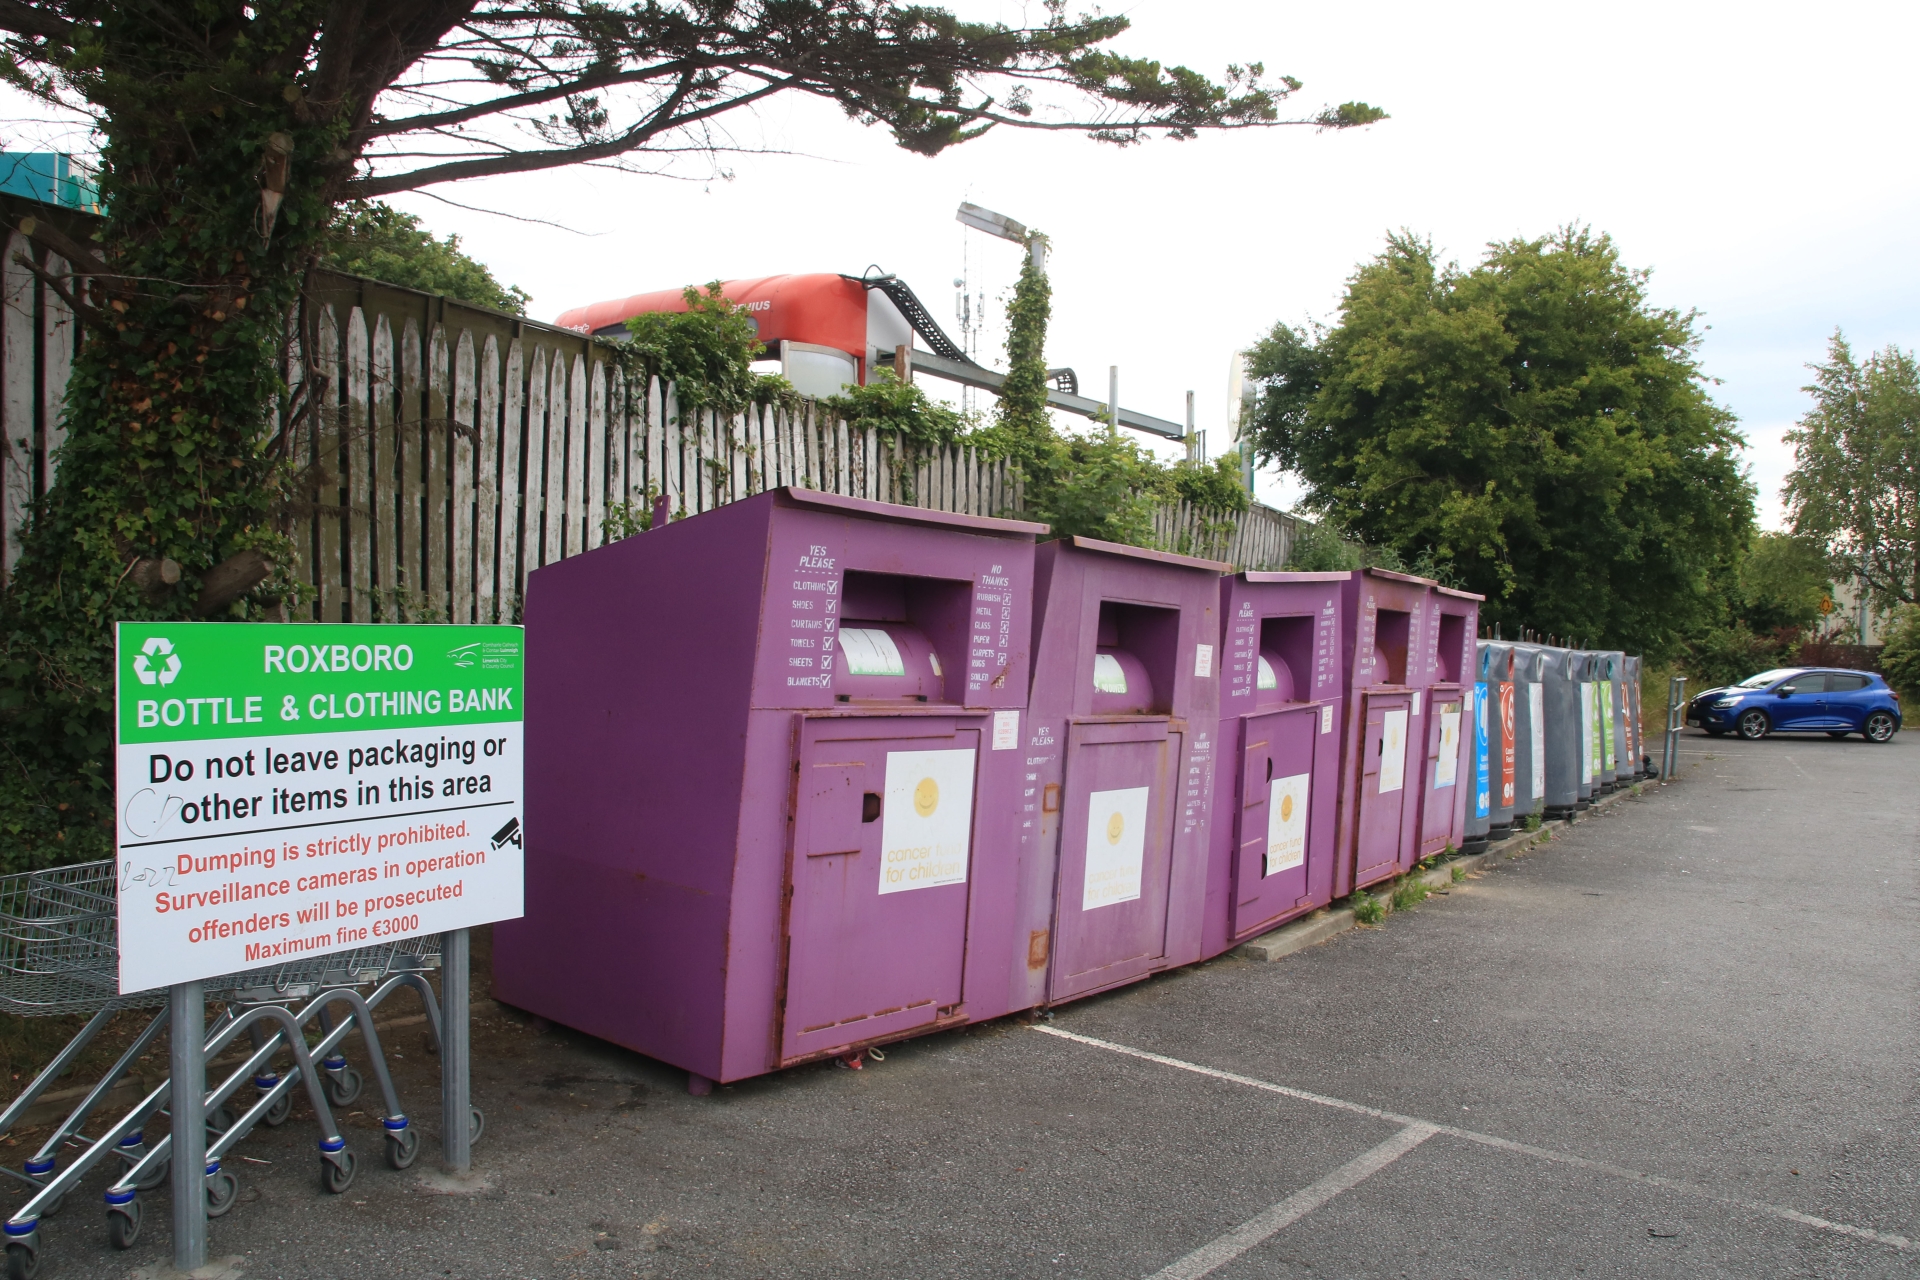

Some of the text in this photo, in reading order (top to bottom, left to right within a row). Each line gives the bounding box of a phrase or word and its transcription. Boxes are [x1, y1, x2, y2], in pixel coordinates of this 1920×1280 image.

[810, 545, 827, 556] YES
[799, 556, 835, 569] PLEASE
[991, 564, 1002, 574] NO
[793, 580, 826, 591] CLOTHING
[982, 575, 1009, 587] THANKS
[976, 592, 1001, 602] RUBBISH
[792, 600, 814, 610] SHOES
[975, 607, 992, 616] METAL
[791, 619, 823, 629] CURTAINS
[974, 621, 991, 630] GLASS
[790, 638, 815, 648] TOWELS
[973, 635, 990, 644] PAPER
[264, 645, 413, 673] ROXBORO
[972, 649, 995, 658] CARPETS
[788, 657, 813, 667] SHEETS
[787, 676, 820, 686] BLANKETS
[137, 687, 512, 728] BOTTLE & CLOTHING BANK
[1038, 727, 1050, 736] YES
[1031, 736, 1054, 746] PLEASE
[150, 736, 507, 784] Do not leave packaging or
[180, 774, 491, 824] other items in this area
[177, 820, 470, 877] Dumping is strictly prohibited.
[887, 842, 962, 863] cancer fund
[885, 860, 960, 883] for children
[156, 851, 485, 913] Surveillance cameras in operation
[189, 881, 463, 943] offenders will be prosecuted
[245, 914, 419, 962] Maximum fine €3000
